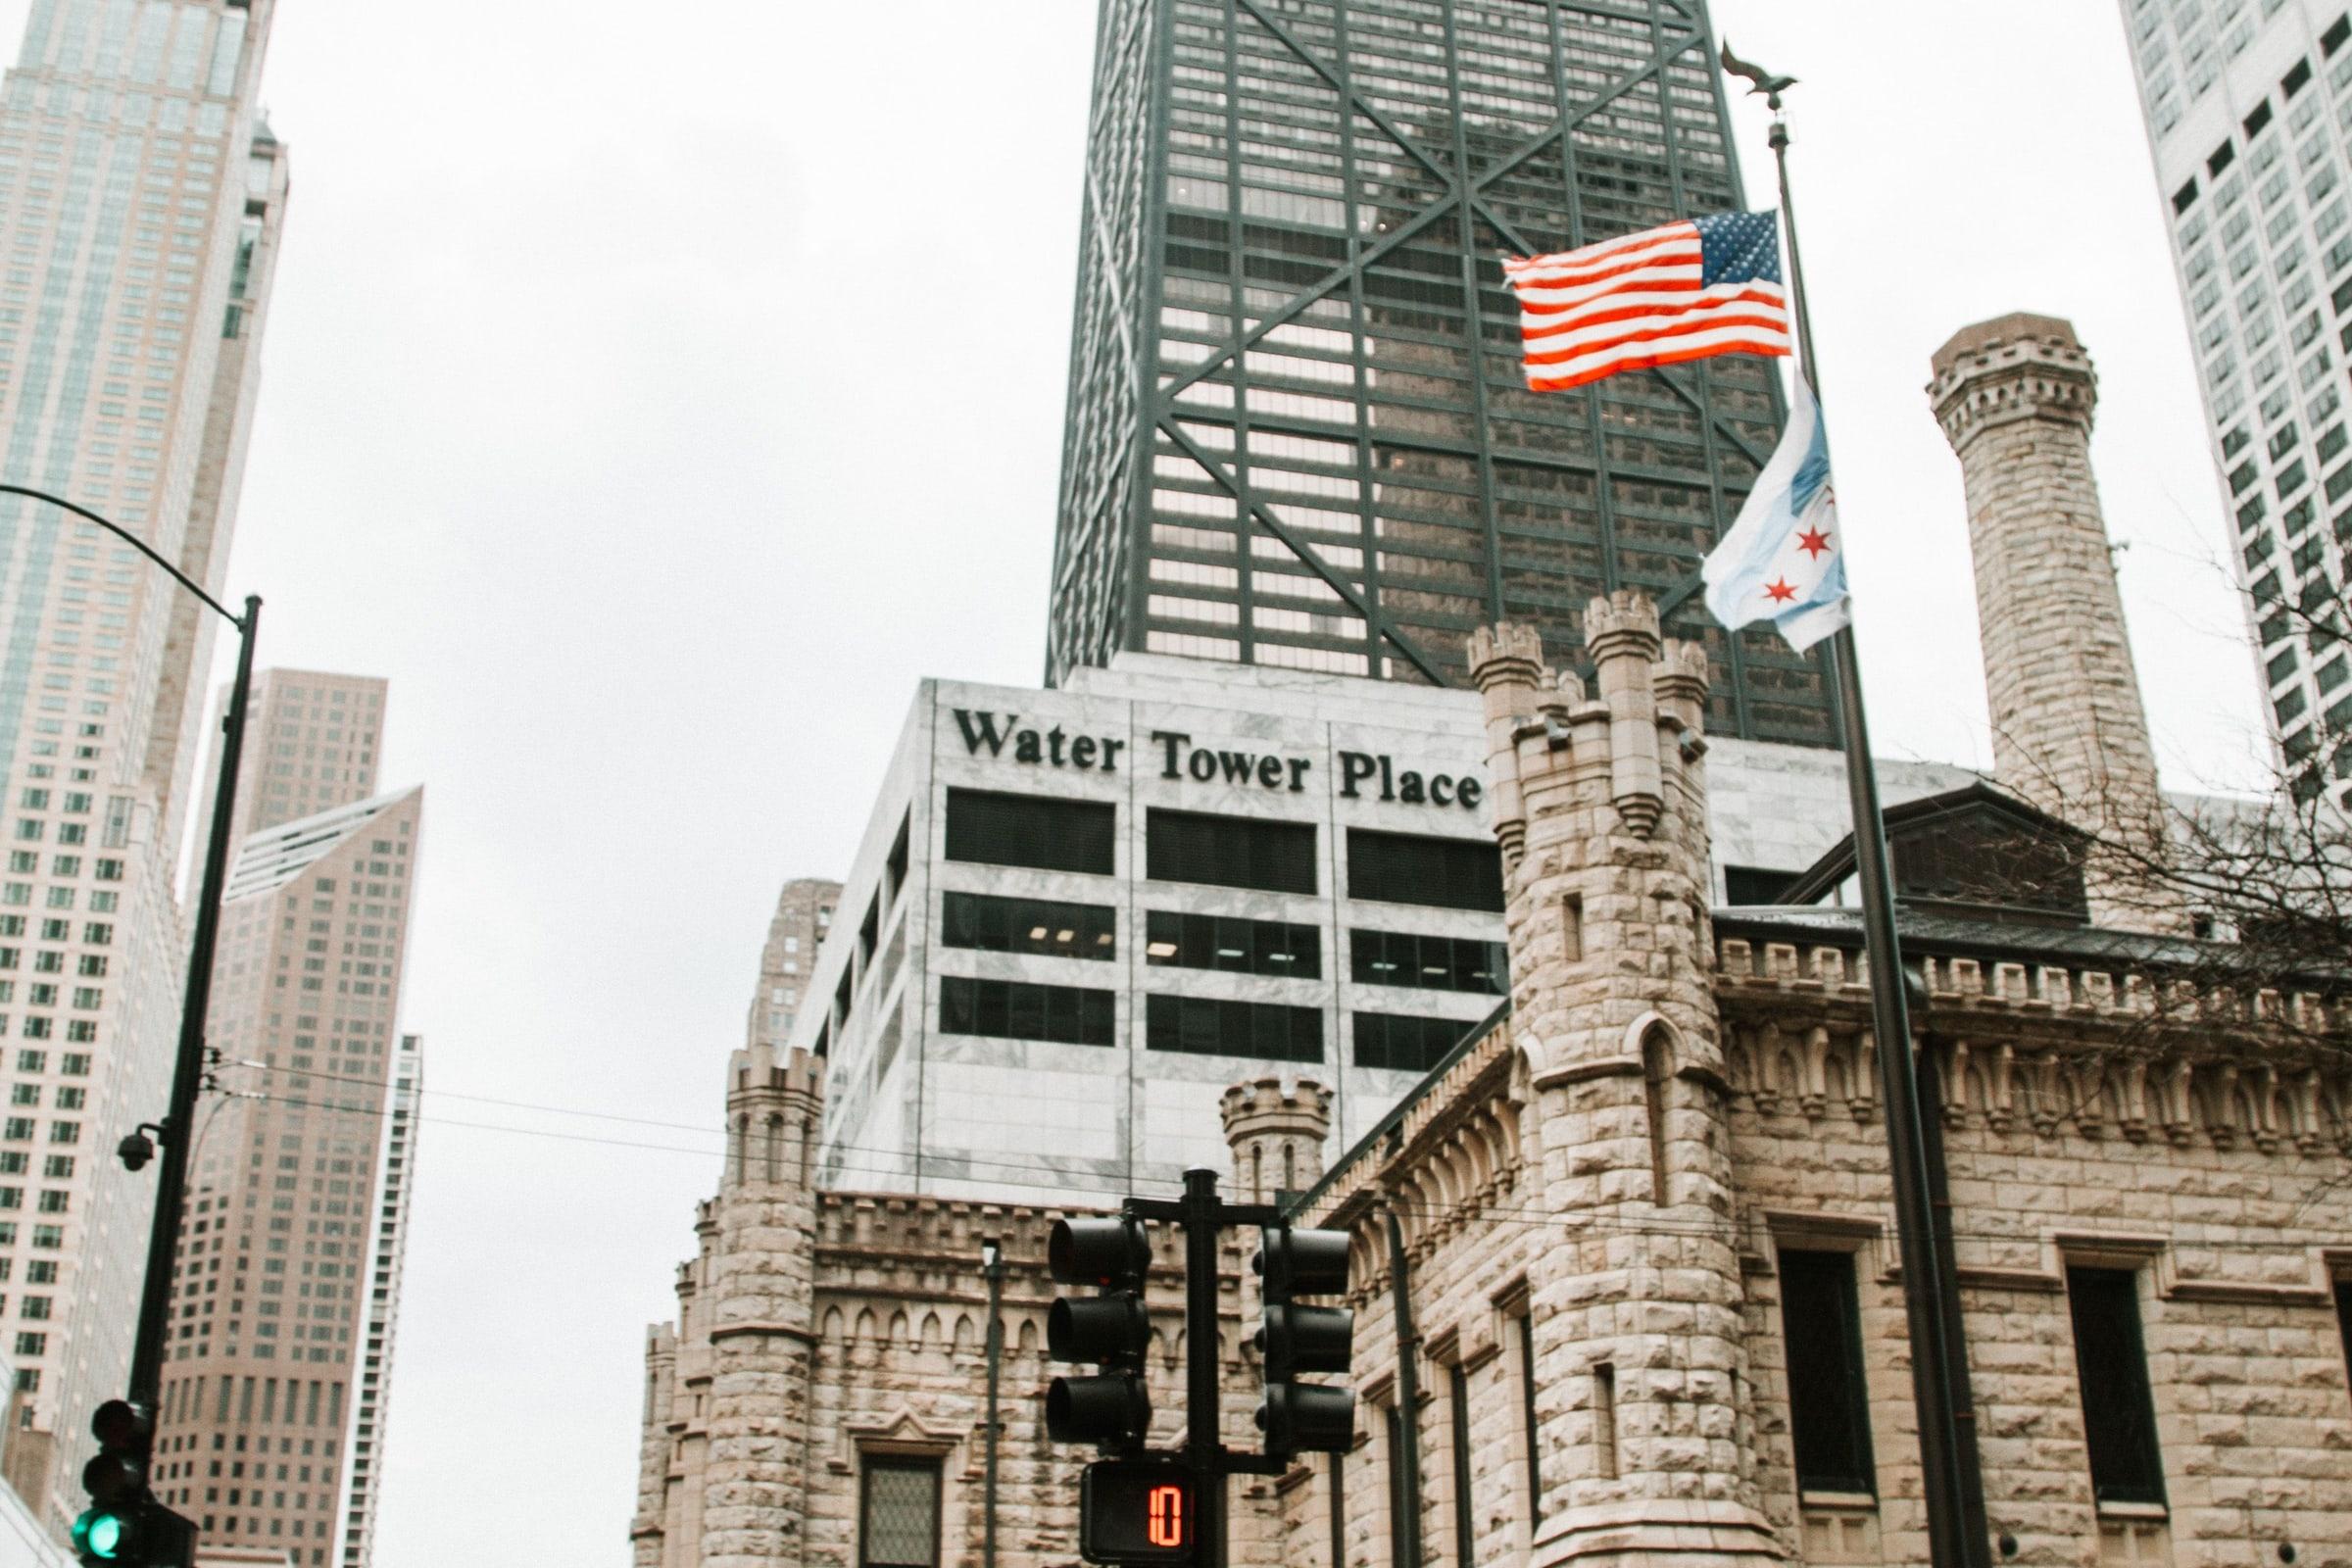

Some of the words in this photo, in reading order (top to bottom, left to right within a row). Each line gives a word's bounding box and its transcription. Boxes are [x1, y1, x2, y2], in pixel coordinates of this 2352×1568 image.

[954, 709, 1125, 772] Water
[1152, 730, 1311, 793] Tower
[1338, 750, 1483, 808] Place
[1149, 1486, 1182, 1546] 10
